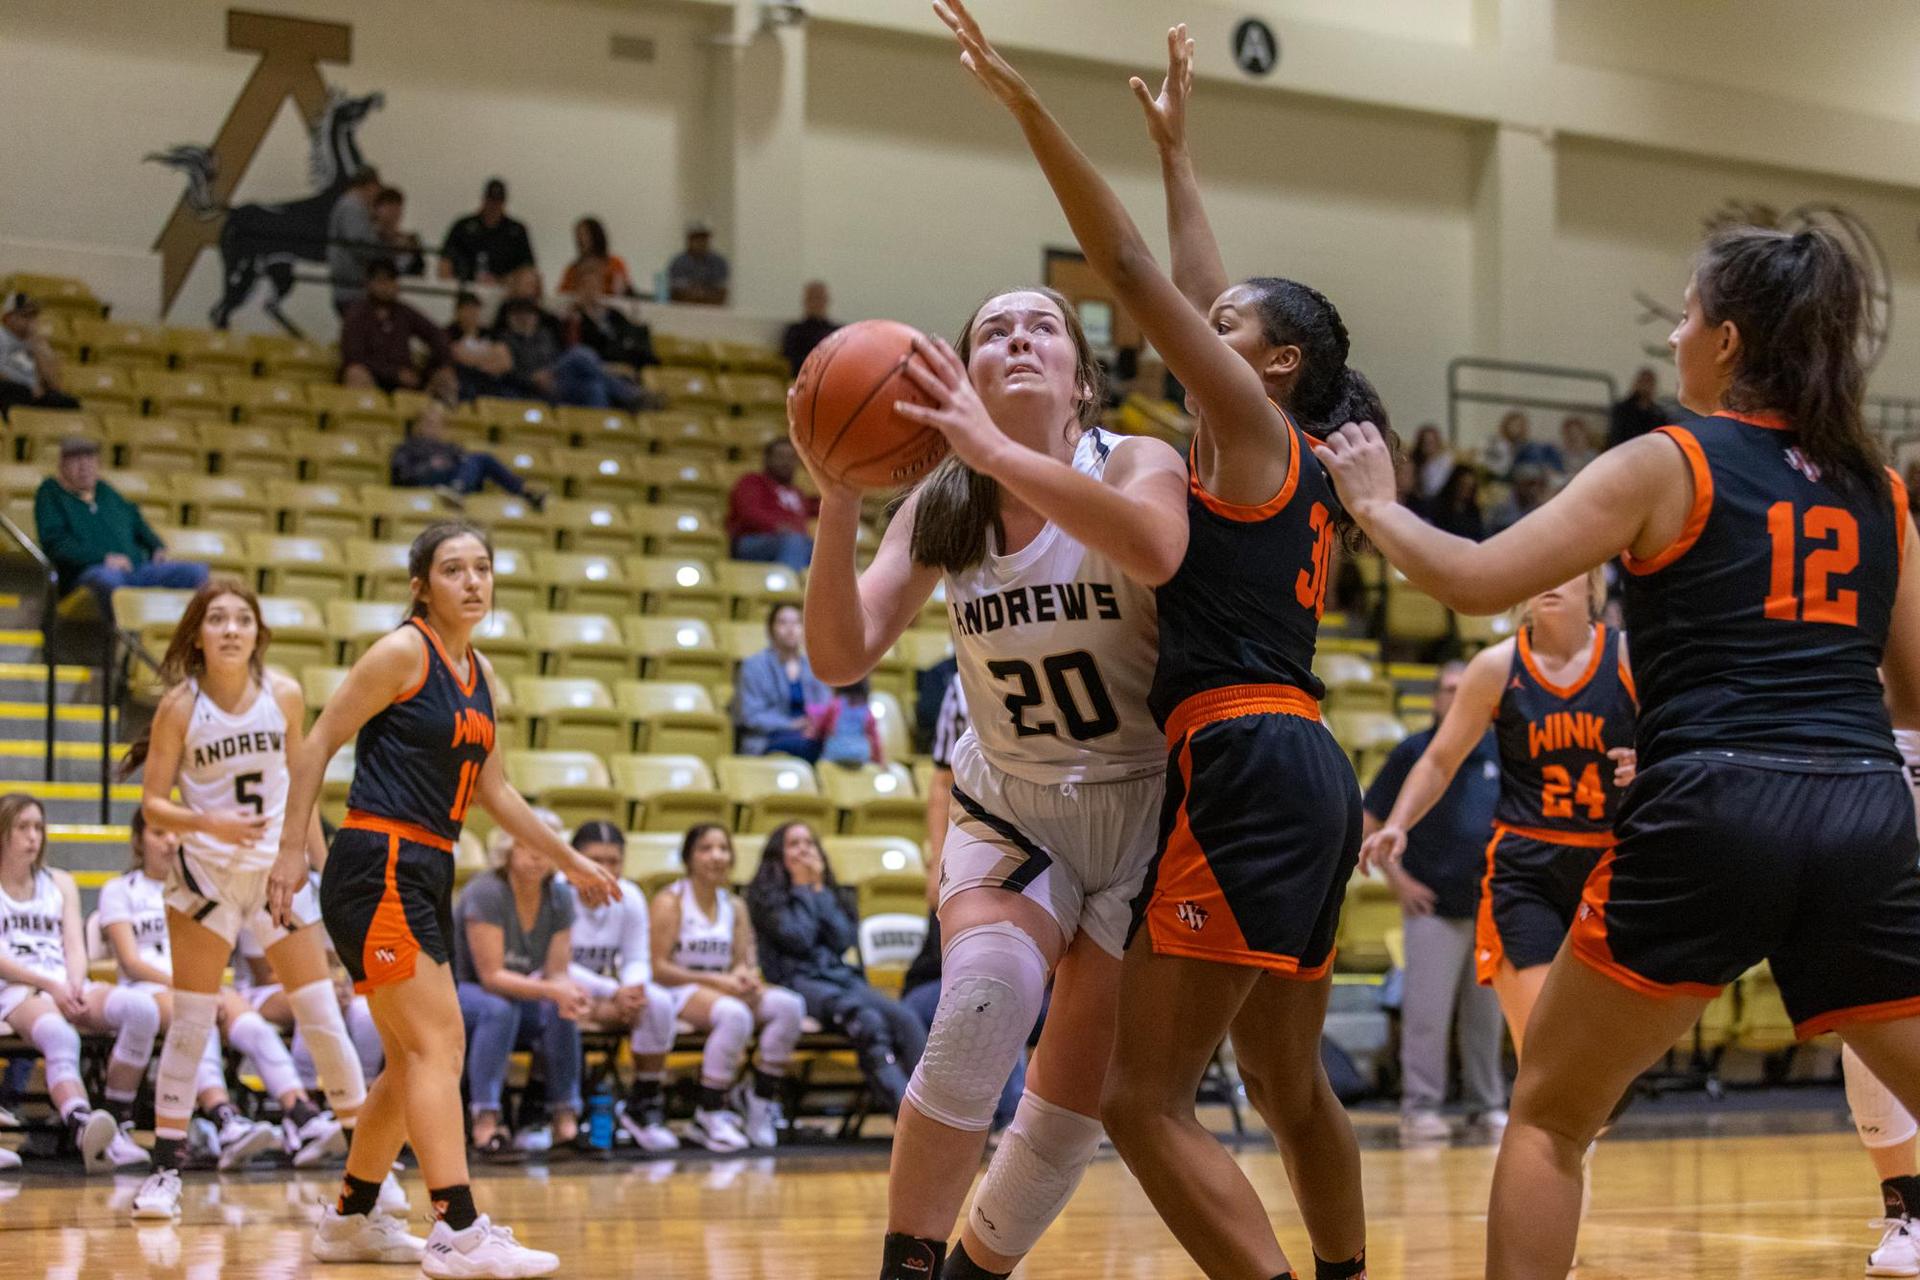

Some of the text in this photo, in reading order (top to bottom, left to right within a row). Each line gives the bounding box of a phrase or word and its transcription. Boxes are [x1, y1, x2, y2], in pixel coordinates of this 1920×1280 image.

[1238, 23, 1273, 71] A
[1763, 500, 1860, 627] 12
[953, 583, 1122, 637] ANDREWS
[986, 651, 1120, 741] 20
[1528, 711, 1606, 758] WINK
[235, 770, 264, 816] 5
[1541, 763, 1606, 819] 24
